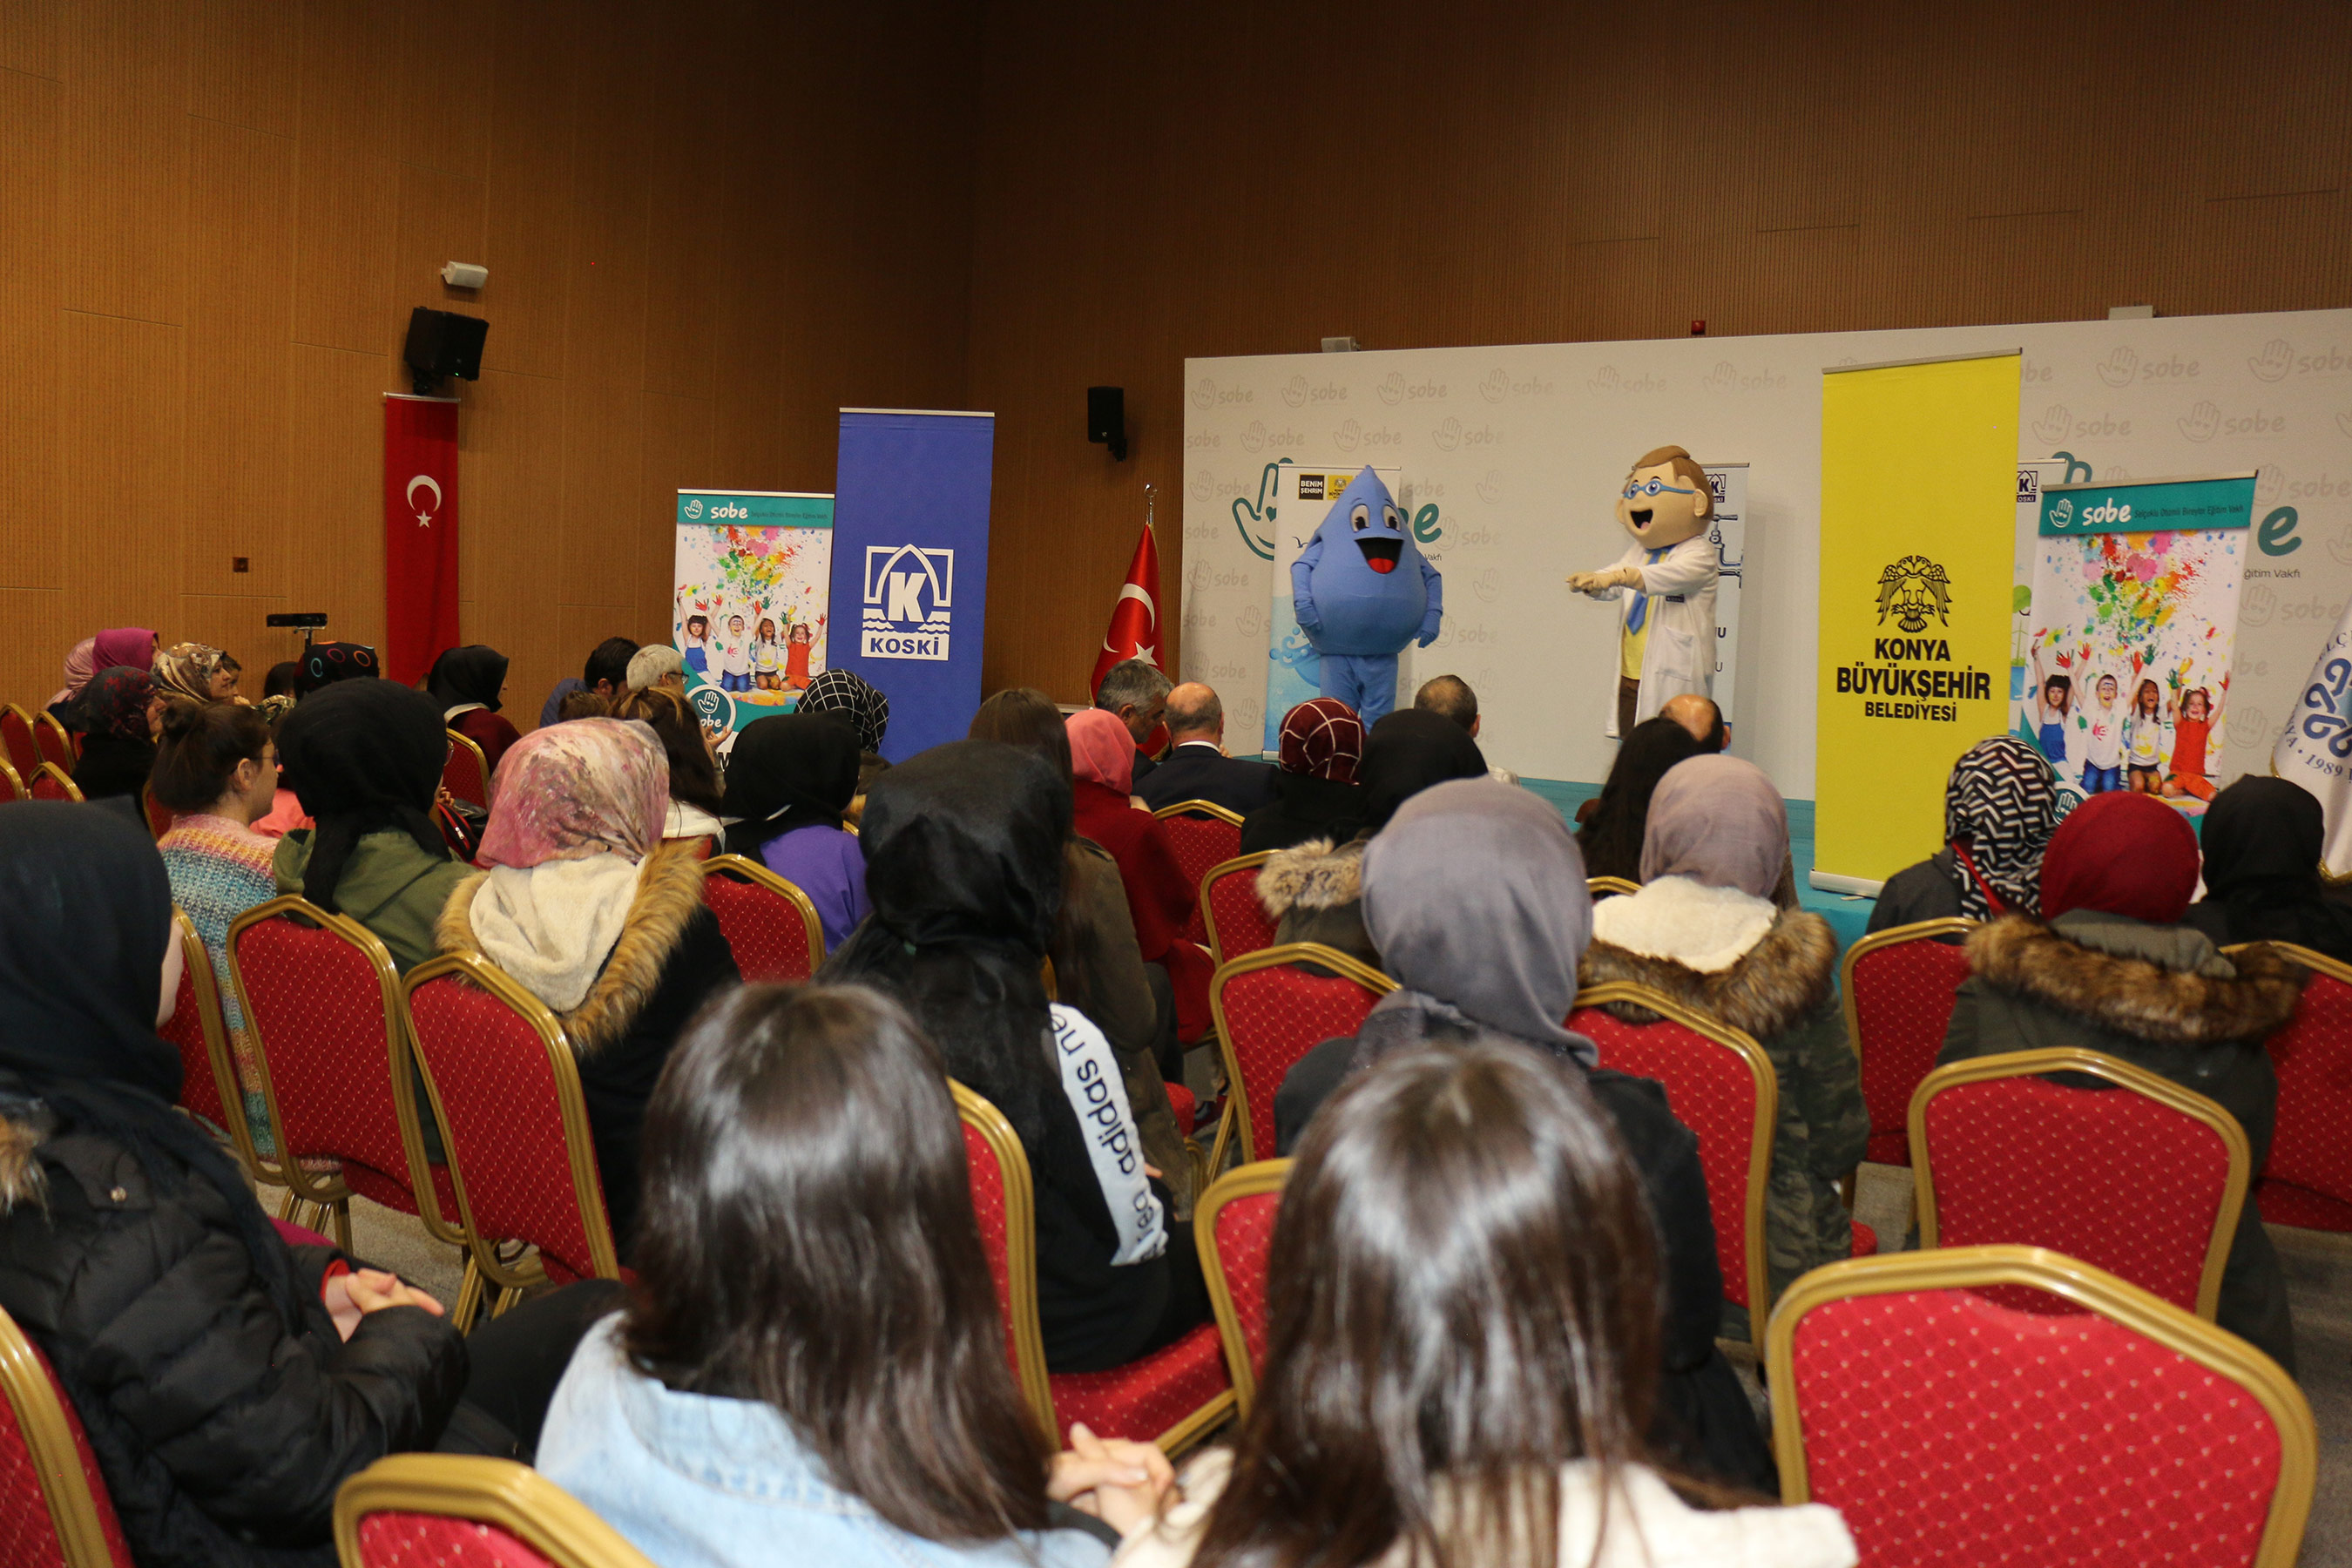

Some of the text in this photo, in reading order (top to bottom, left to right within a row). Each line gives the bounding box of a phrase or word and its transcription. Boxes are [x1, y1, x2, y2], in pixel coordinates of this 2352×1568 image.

[2020, 359, 2053, 382] be
[2142, 355, 2200, 381] sobe
[1219, 385, 1254, 405] sobe
[1310, 381, 1348, 402] sobe
[1408, 378, 1448, 400] sobe
[2075, 412, 2132, 436] sobe
[2224, 409, 2286, 435] sobe
[1186, 429, 1220, 449] sobe
[1267, 426, 1305, 448] sobe
[1363, 426, 1402, 446] sobe
[1216, 476, 1251, 497] sobe
[710, 502, 748, 519] sobe
[2082, 497, 2132, 526] sobe
[1185, 520, 1220, 541] sobe
[1214, 571, 1249, 588] sobe
[2244, 569, 2271, 580] ğitim
[870, 637, 939, 656] KOSKİ
[1875, 638, 1951, 662] KONYA
[1211, 661, 1247, 679] sobe
[2233, 652, 2268, 677] be
[1836, 661, 1990, 702] BÜYÜKŞEHİR
[700, 714, 722, 728] obe
[1865, 700, 1957, 722] BELEDİYESİ
[2305, 754, 2343, 777] 1989
[1051, 1013, 1085, 1057] ne
[1077, 1058, 1136, 1176] adidas
